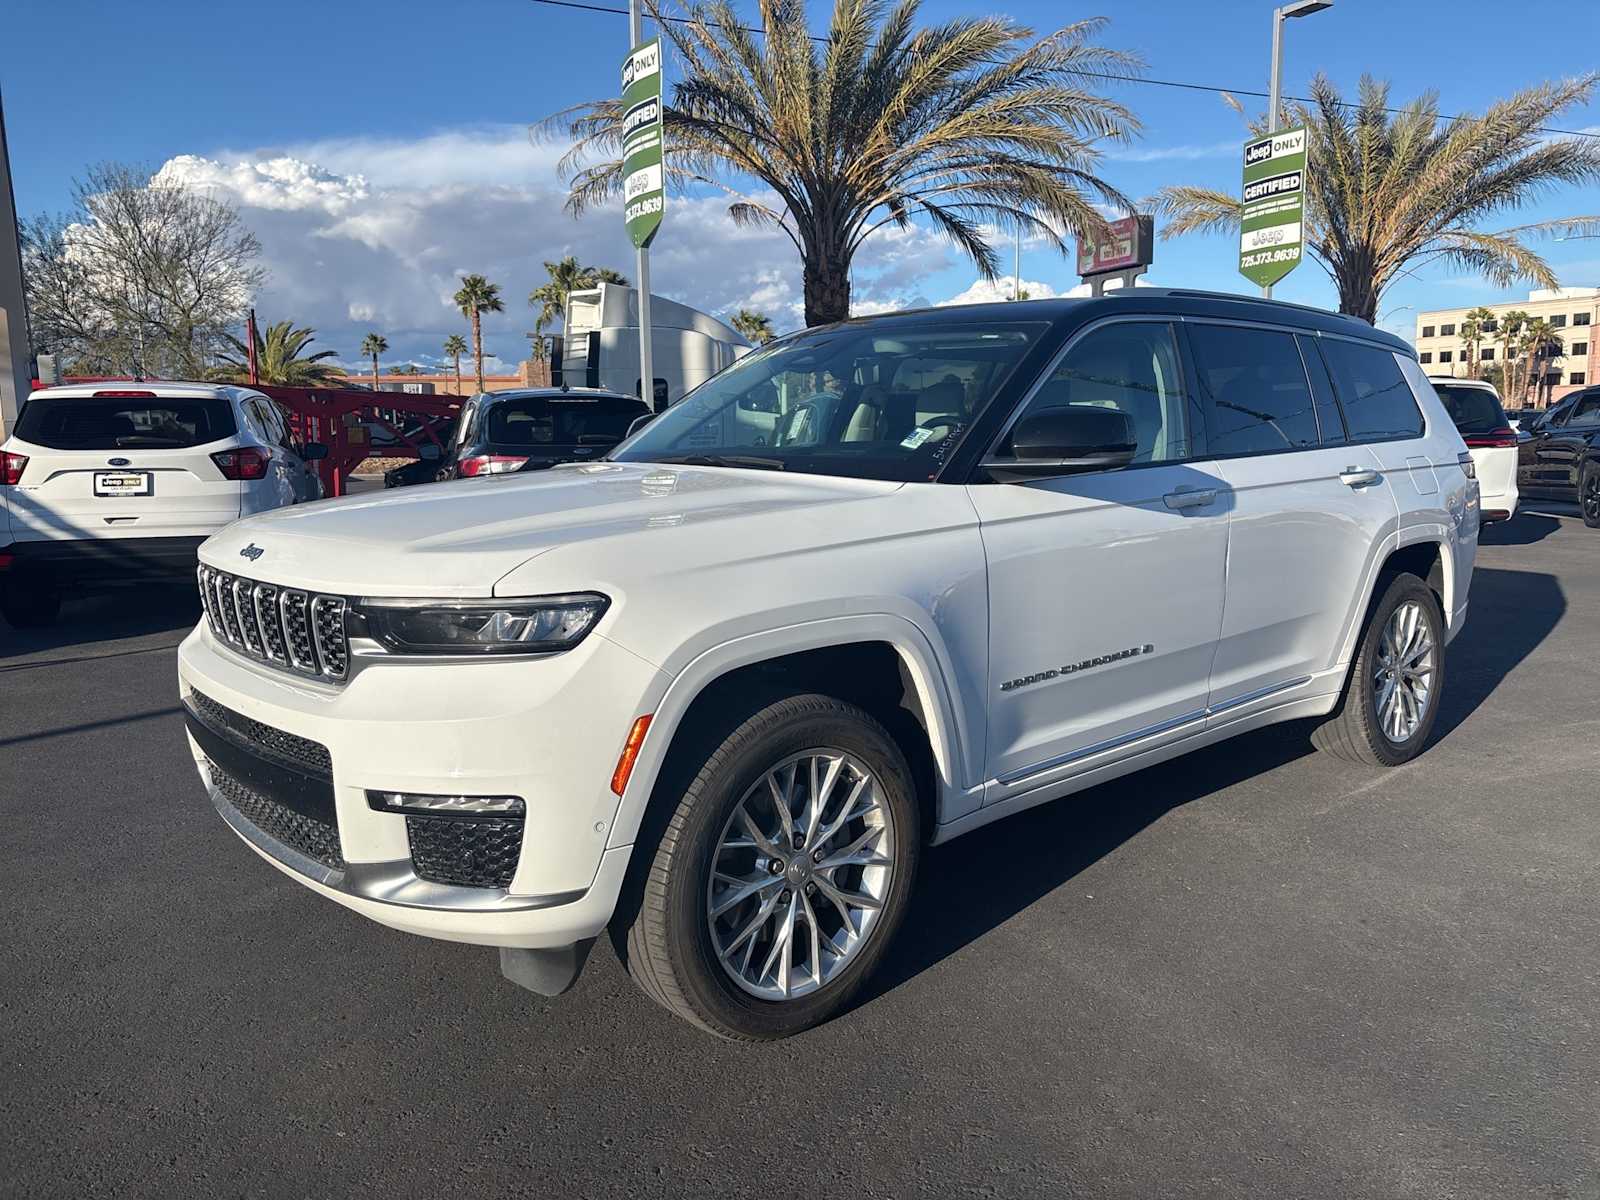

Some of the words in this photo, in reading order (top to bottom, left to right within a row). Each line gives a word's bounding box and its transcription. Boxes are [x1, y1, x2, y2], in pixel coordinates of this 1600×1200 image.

[634, 52, 656, 73] ONLY
[1248, 144, 1271, 161] Jeep
[1274, 136, 1302, 152] ONLY
[1245, 175, 1299, 199] CERTIFIED
[1252, 229, 1285, 247] Jeep
[1241, 247, 1300, 269] 725.373.9639
[240, 543, 264, 561] Jeep
[1000, 669, 1058, 691] GRAND
[1059, 647, 1140, 675] CHEROKEE
